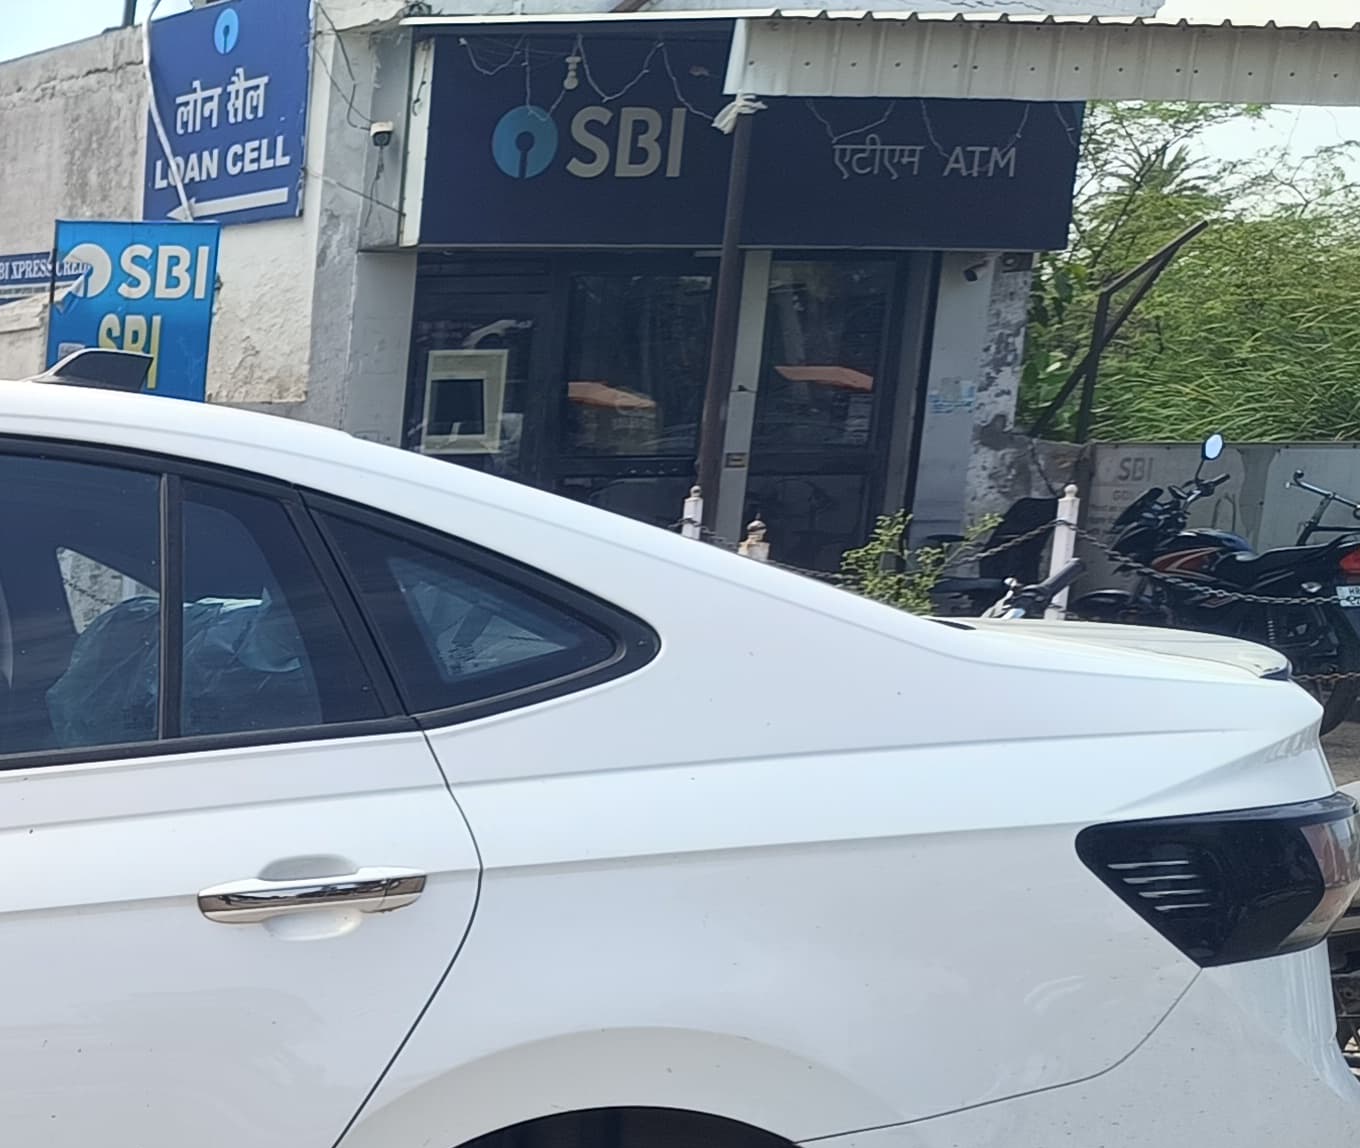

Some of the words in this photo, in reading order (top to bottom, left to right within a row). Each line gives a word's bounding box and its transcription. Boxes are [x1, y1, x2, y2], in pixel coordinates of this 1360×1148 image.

[176, 80, 222, 135] लोन
[227, 67, 270, 125] सैल
[154, 148, 219, 189] LOAN
[226, 135, 291, 176] CELL
[566, 106, 686, 178] SBI
[832, 133, 925, 180] एटीएम
[943, 146, 1017, 178] ATM
[11, 258, 53, 280] XPRESS
[118, 244, 210, 299] SBI
[1117, 457, 1155, 481] SBI
